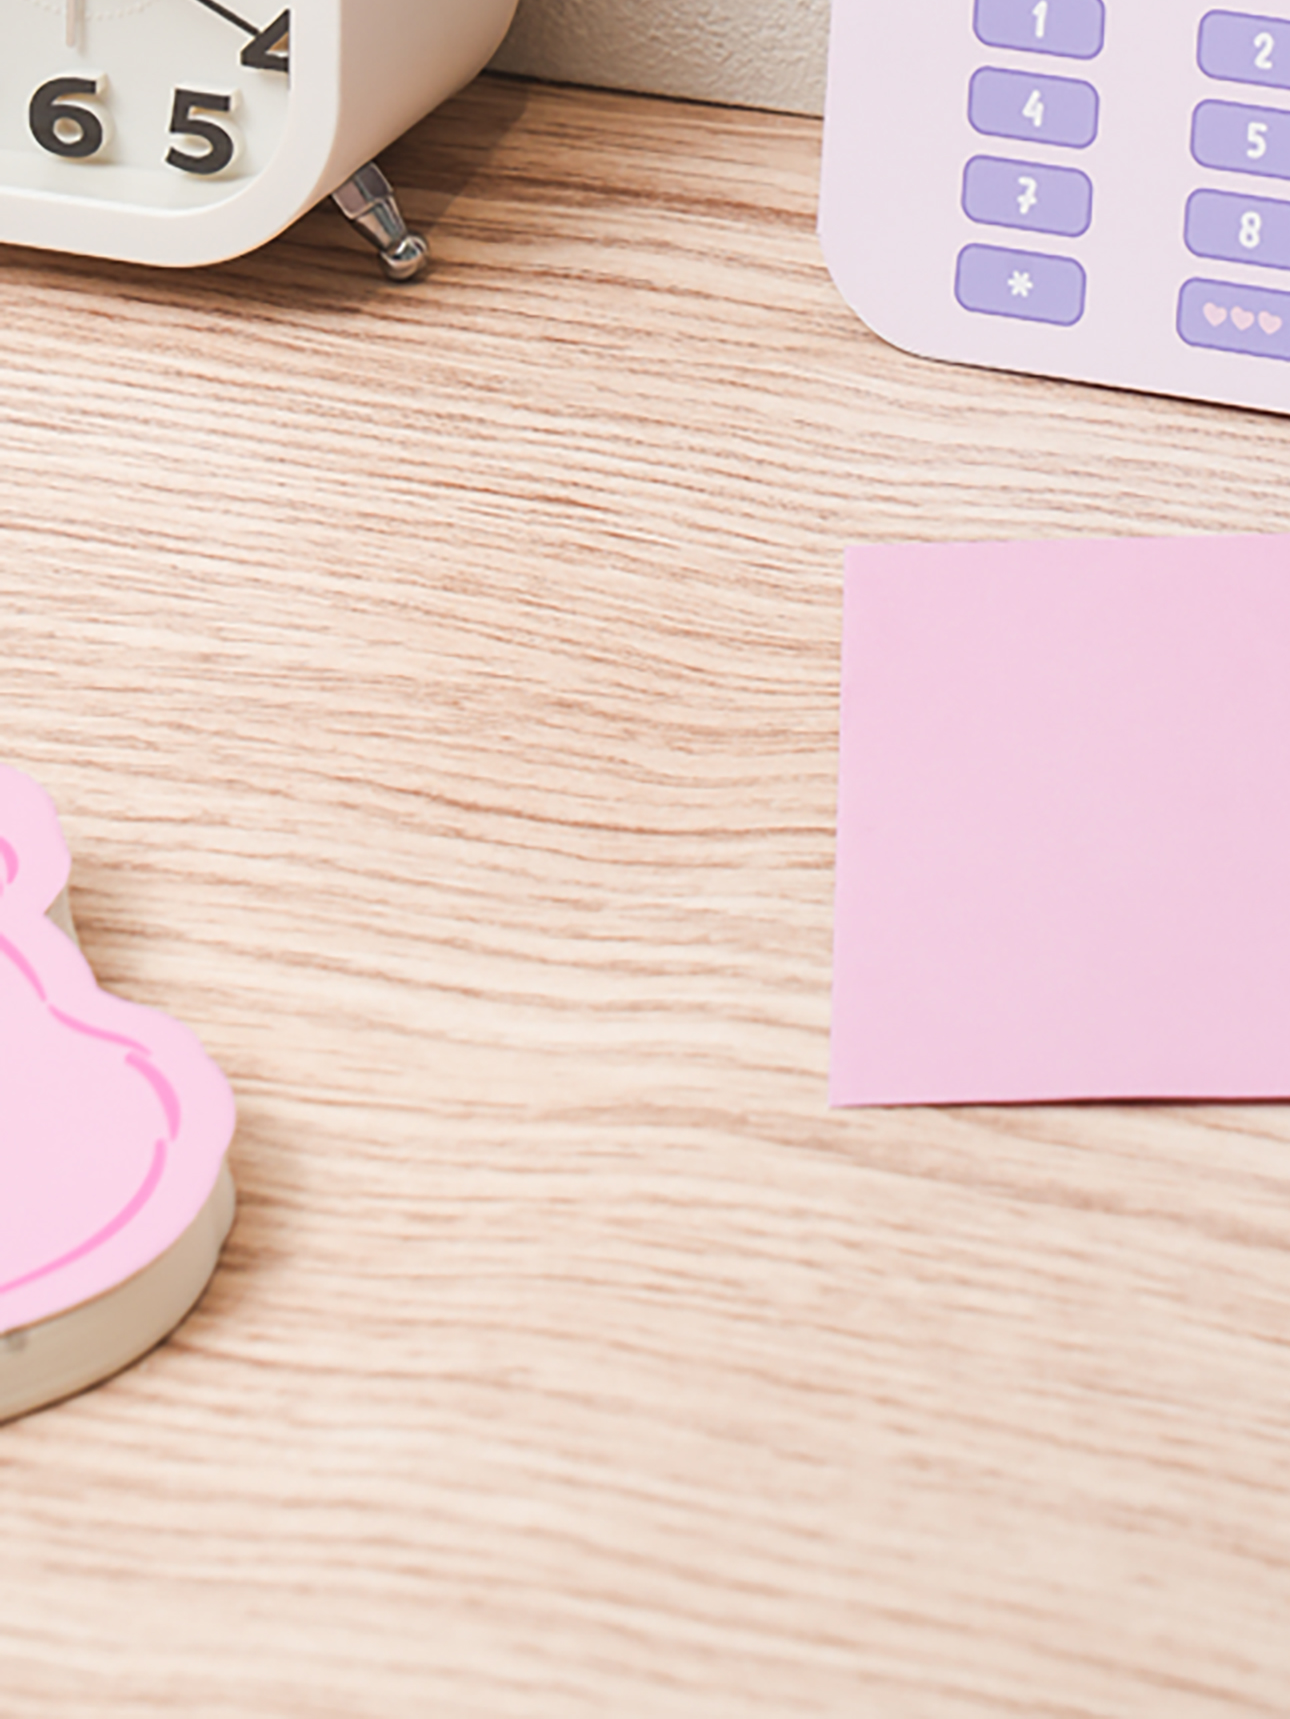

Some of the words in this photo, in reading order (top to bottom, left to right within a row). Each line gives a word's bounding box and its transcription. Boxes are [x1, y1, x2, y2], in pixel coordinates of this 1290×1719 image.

[1032, 0, 1048, 38] 1
[1253, 32, 1275, 70] 2
[29, 77, 103, 158] 6
[166, 89, 234, 175] 5
[1022, 89, 1044, 127] 4
[1246, 121, 1268, 159] 5
[1017, 176, 1037, 215] 7
[1238, 211, 1262, 249] 8
